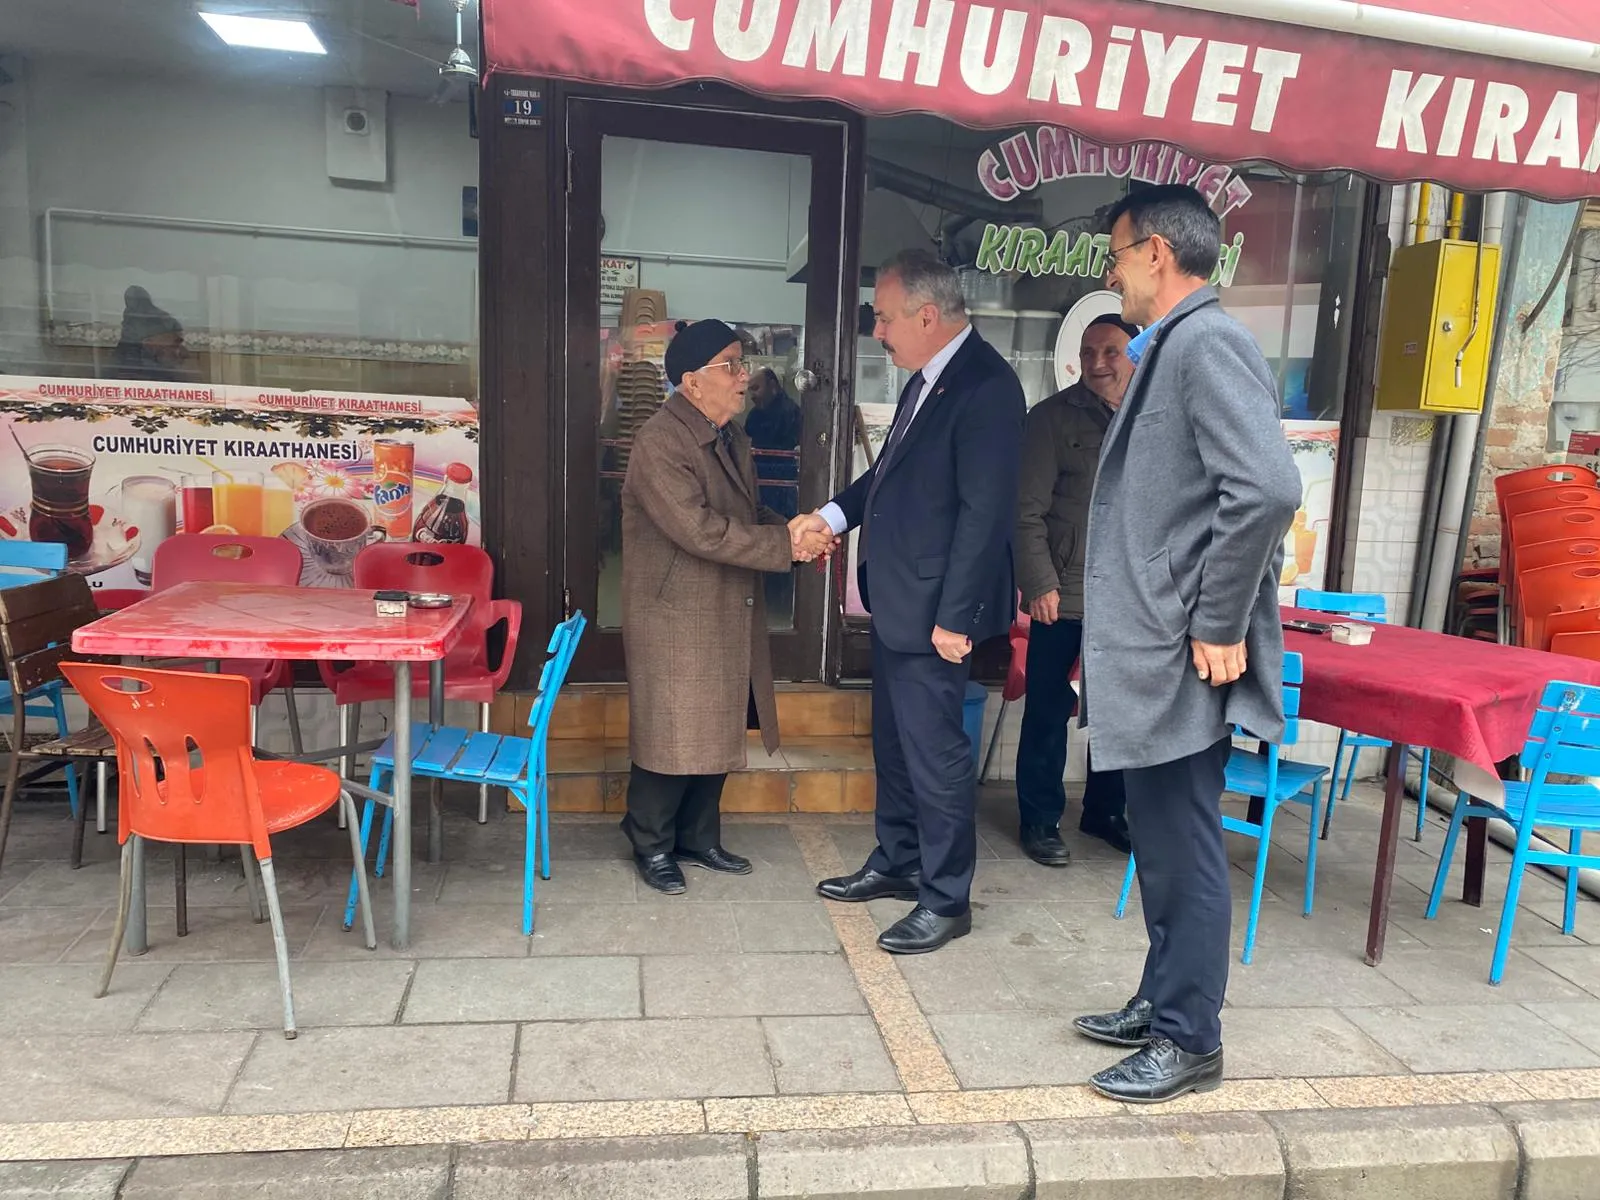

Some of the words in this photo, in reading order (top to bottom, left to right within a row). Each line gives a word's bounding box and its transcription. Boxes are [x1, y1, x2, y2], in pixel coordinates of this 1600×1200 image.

[643, 0, 1302, 133] CUMHURİYET
[515, 100, 532, 115] 19
[38, 383, 120, 398] CUMHURİYET
[124, 387, 213, 401] KIRAATHANESİ
[258, 394, 335, 408] CUMHURİYET
[338, 398, 422, 413] KIRAATHANESİ
[93, 435, 218, 456] CUMHURİYET
[224, 440, 358, 460] KIRAATHANESİ
